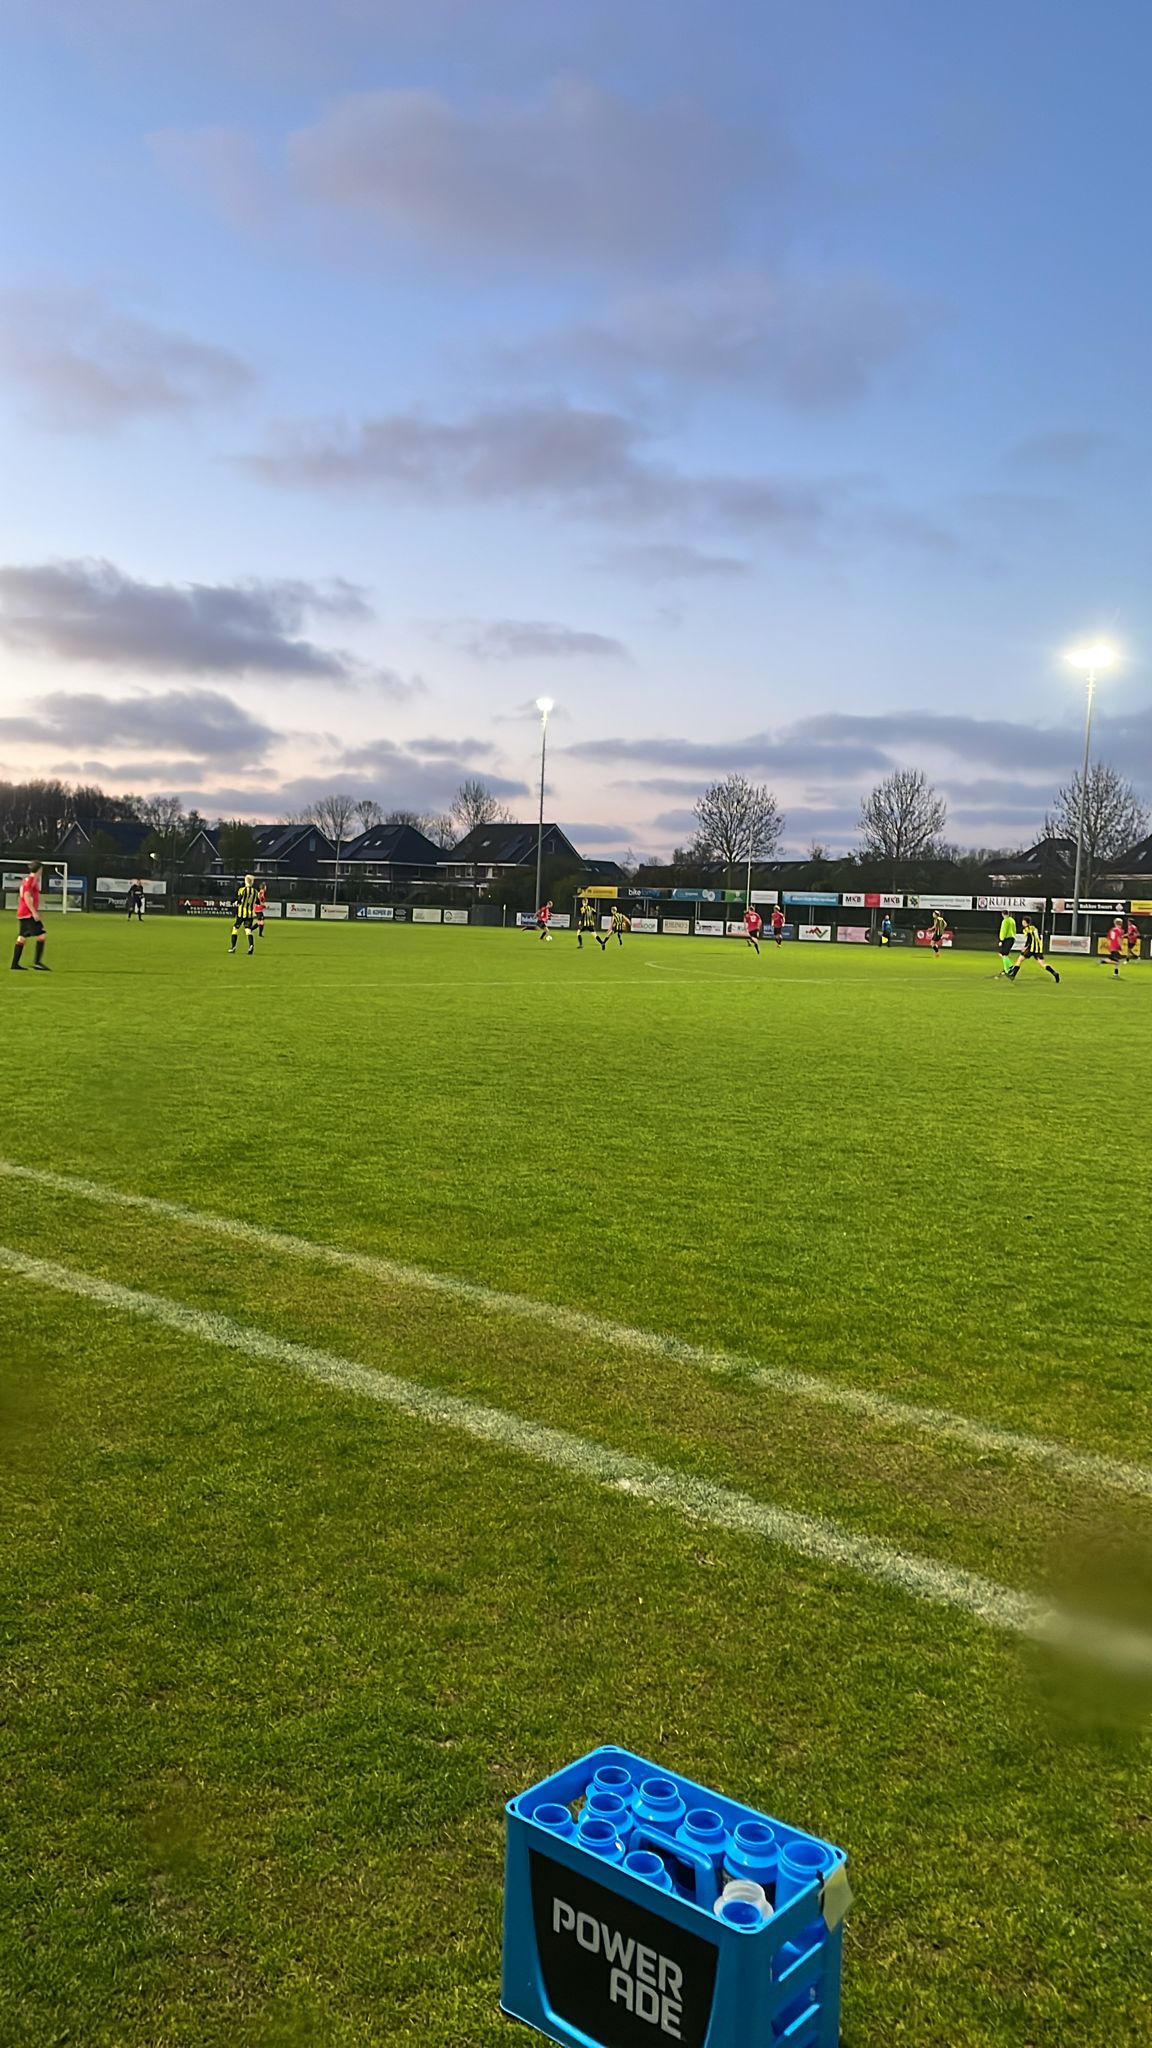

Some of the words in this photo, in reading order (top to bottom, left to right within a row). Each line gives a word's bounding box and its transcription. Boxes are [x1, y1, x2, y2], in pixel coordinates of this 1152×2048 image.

[989, 897, 1026, 907] RUITER
[552, 1897, 683, 2003] POWER
[609, 1967, 683, 2040] ADE
